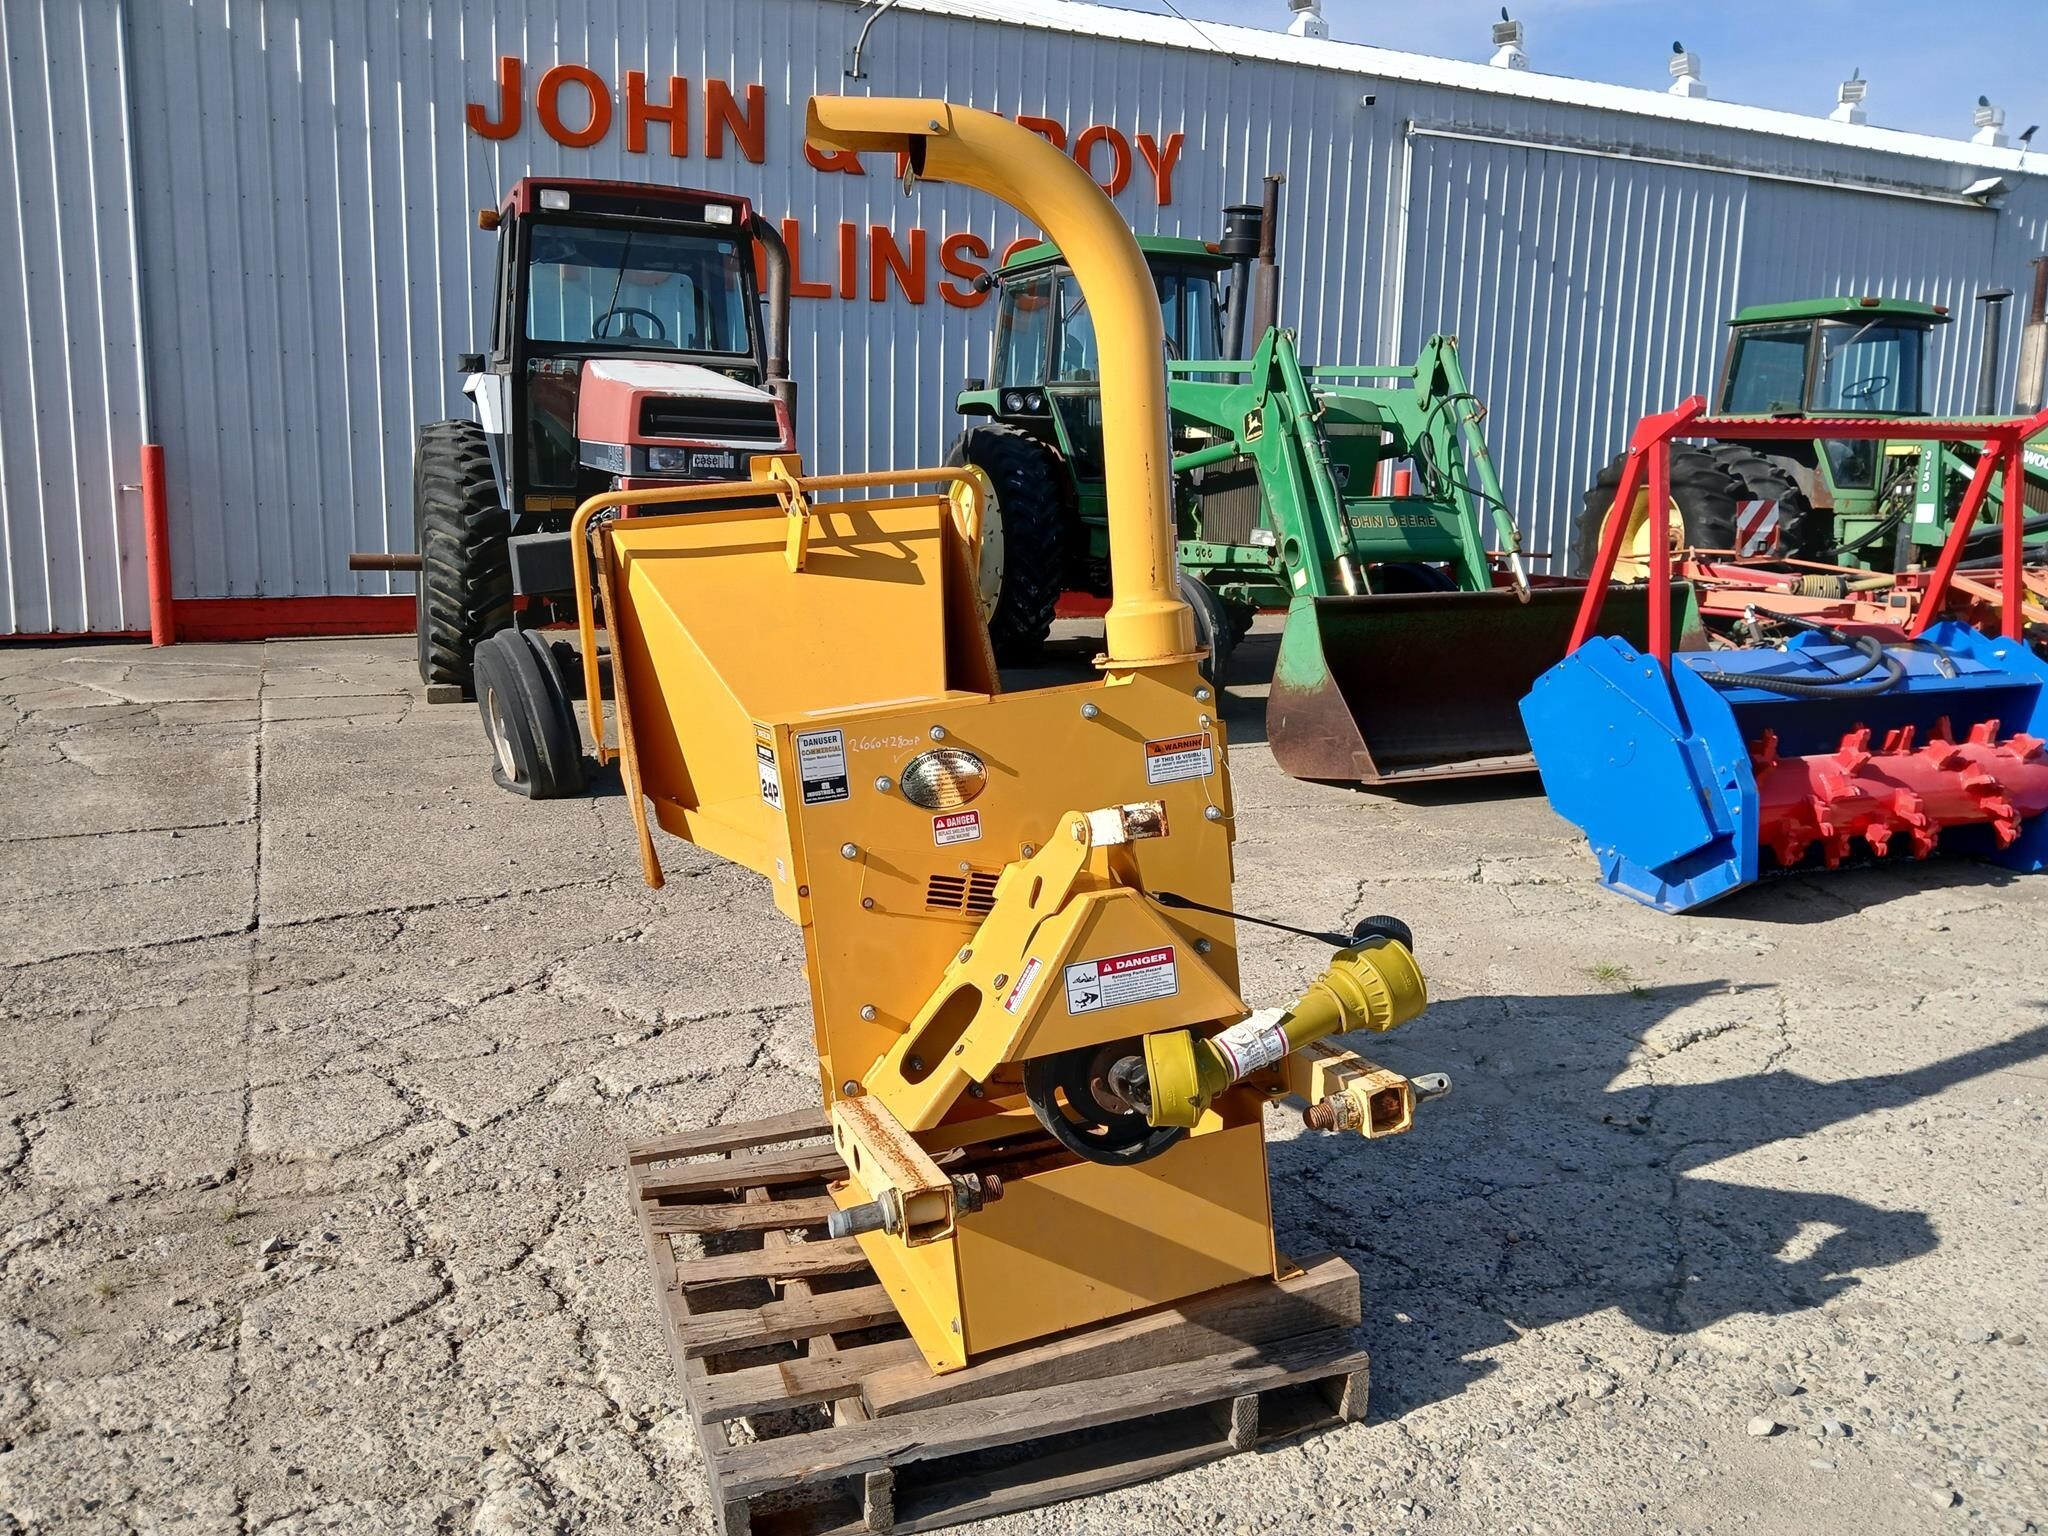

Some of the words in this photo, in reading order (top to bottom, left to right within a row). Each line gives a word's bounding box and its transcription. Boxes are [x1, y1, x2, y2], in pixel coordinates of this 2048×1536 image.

[467, 56, 765, 164] JOHN
[1922, 450, 1932, 493] 3150
[1350, 515, 1384, 529] OHN
[1387, 514, 1438, 528] DEERE
[803, 735, 838, 747] DANUSER
[801, 745, 842, 756] COMMERCIAL
[761, 778, 779, 803] 24P
[946, 814, 976, 828] DANGER
[1115, 953, 1168, 970] DANGER
